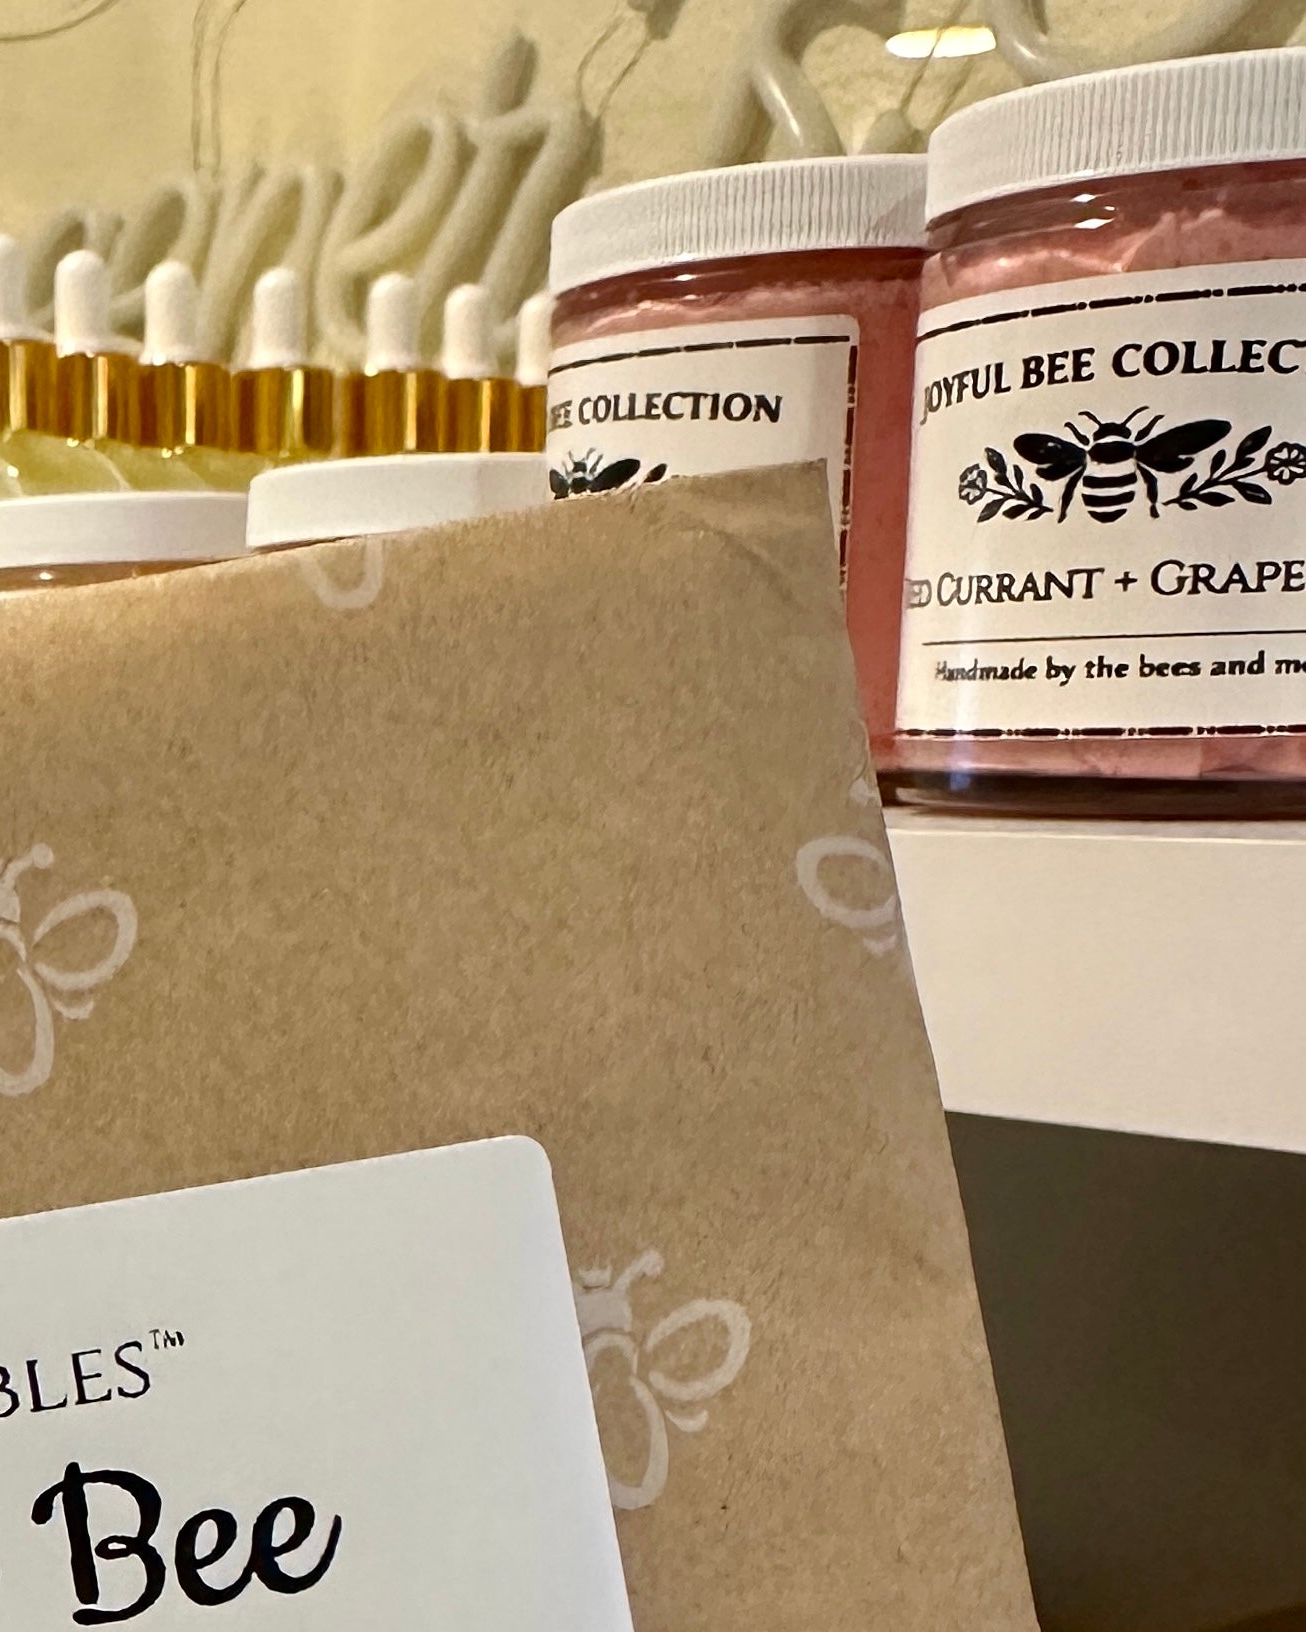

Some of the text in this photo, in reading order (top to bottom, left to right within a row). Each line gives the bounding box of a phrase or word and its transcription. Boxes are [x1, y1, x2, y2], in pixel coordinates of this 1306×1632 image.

[920, 338, 1306, 426] JOYFUL BEE COLLEC
[578, 391, 783, 425] COLLECTION
[936, 567, 1106, 607] CURRANT
[934, 656, 1039, 682] Handmade
[1045, 655, 1078, 687] by
[1084, 655, 1131, 680] the
[1138, 653, 1202, 678] bees
[1209, 649, 1266, 677] and
[29, 1460, 343, 1627] Bee
